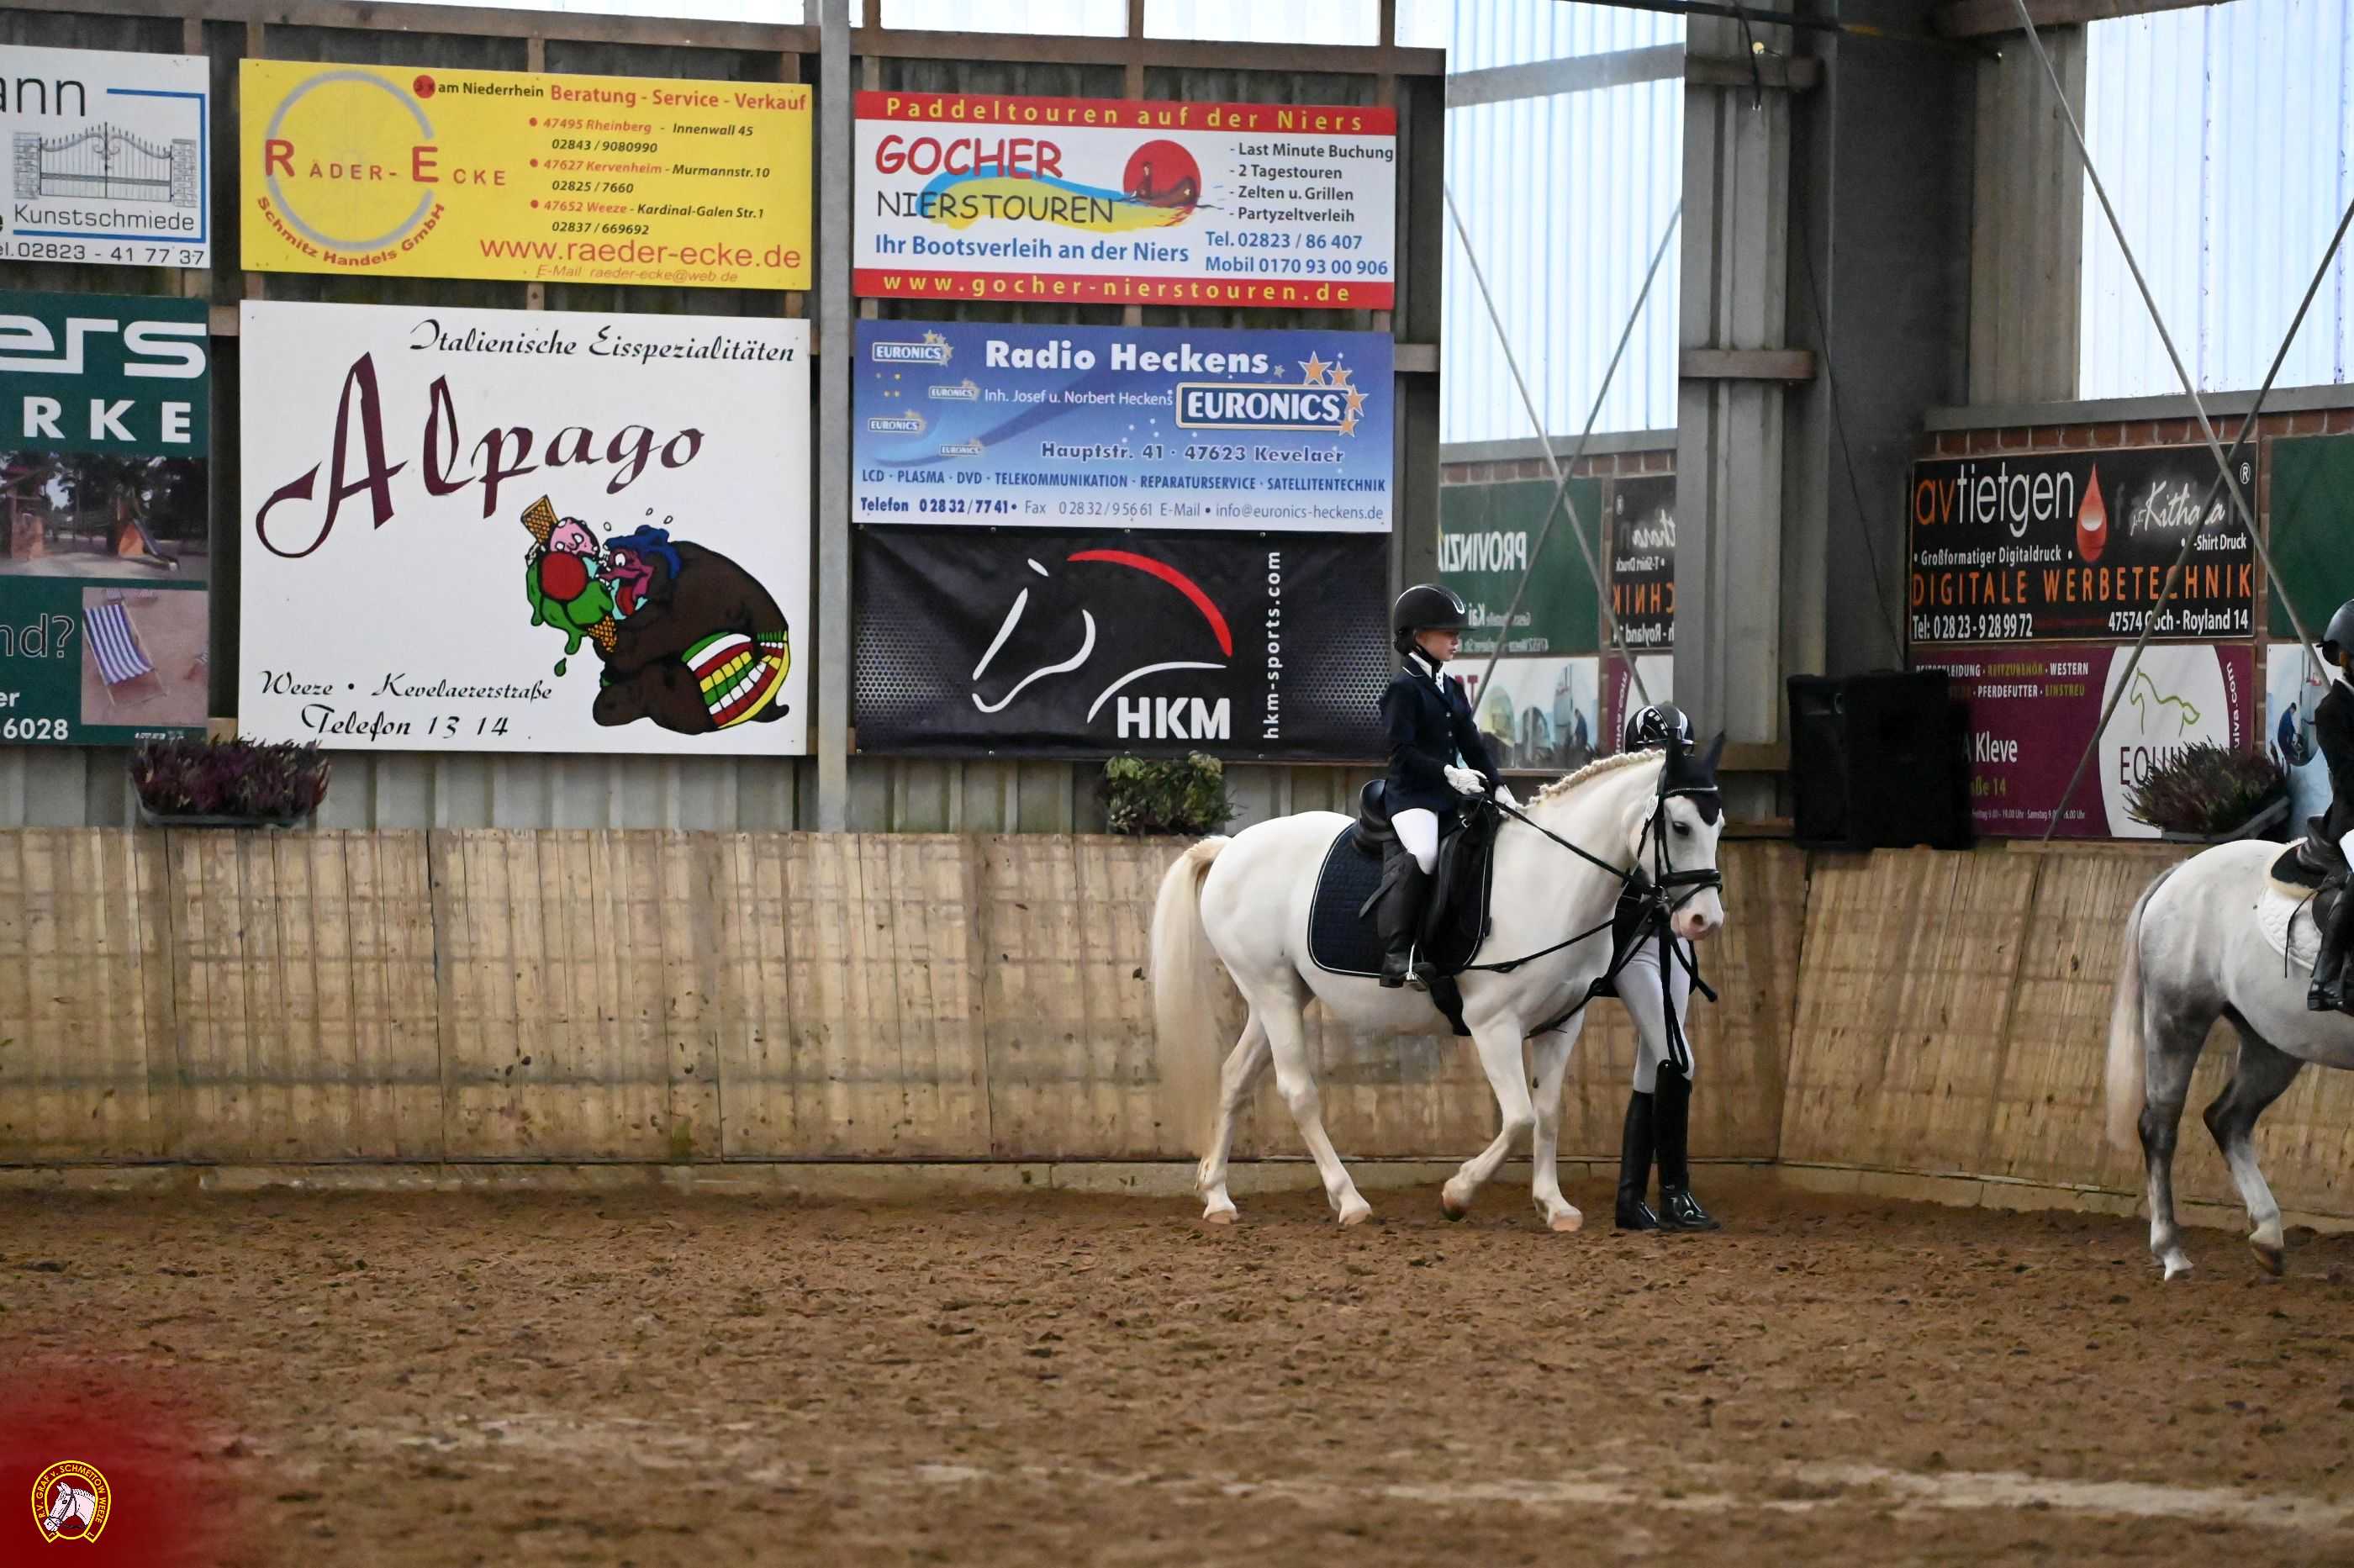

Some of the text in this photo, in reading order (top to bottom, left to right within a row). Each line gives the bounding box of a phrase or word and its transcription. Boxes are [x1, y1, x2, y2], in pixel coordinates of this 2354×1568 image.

[0, 77, 85, 116] nn
[438, 84, 459, 93] am
[463, 82, 544, 98] Niederrhein
[551, 85, 636, 108] Beratung
[652, 89, 719, 107] Service
[735, 92, 806, 111] Verkauf
[542, 118, 753, 136] 47495 Rheinberg Innenwall 45
[887, 98, 1362, 131] Paddeltouren auf der Niers
[552, 139, 657, 153] 02843 9080990
[875, 135, 1063, 180] GOCHER
[1238, 143, 1393, 162] Last Minute Buchung
[544, 159, 583, 170] 47627
[586, 161, 662, 174] Kervenheim
[1238, 165, 1342, 181] 2 Tagestouren
[552, 181, 634, 193] 02825 7660
[1238, 186, 1354, 201] Zelten u. Grillen
[15, 203, 194, 230] Kunstschmiede
[544, 200, 583, 212] 47652
[587, 201, 627, 214] Weeze
[637, 203, 733, 218] Kardinal-Galen
[877, 191, 1113, 224] NIERSTOUREN
[1238, 207, 1354, 223] Partyzeltverleih
[257, 196, 445, 267] Schmitz Handels GmbH
[552, 222, 649, 235] 02837 669692
[1206, 230, 1362, 250] Tel. 02823 86 407
[111, 247, 133, 261] 41
[145, 249, 170, 262] 77
[180, 251, 204, 265] 37
[480, 239, 801, 268] www.raeder-ecke.de
[876, 234, 1189, 261] Ihr Bootsverleih an der Niers
[1205, 256, 1387, 274] Mobil 0170 93 00 906
[884, 275, 1350, 301] www.gocher-nierstouren.de
[410, 318, 795, 366] Italienische Eisspezialitäten
[877, 346, 942, 359] EURONICS
[986, 340, 1269, 374] Radio Heckens
[985, 388, 1173, 405] Inh. Josef u. Norbert Heckens
[1187, 391, 1340, 421] EURONICS
[255, 351, 705, 559] Alpago
[1042, 441, 1344, 462] Hauptstr. 41 47623 Kevelaer
[863, 469, 1385, 492] LCD PLASMA DVD TELEKOMMUNIKATION REPARATURSERVICE SATELLITENTECHNIK
[861, 497, 908, 511] Telefon
[1025, 501, 1046, 514] Fax
[1160, 503, 1200, 516] E-Mail
[1217, 504, 1384, 520] info@euronics-heckens.de
[1915, 462, 2074, 538] avtietgen
[2145, 480, 2225, 531] Kithaa
[1921, 547, 1996, 570] Großformatiger
[1998, 545, 2061, 566] Digitaldruck
[2219, 532, 2246, 550] Druck
[1912, 570, 2027, 606] DIGITALE
[1913, 614, 1930, 639] Tel:
[2109, 611, 2142, 631] 47574
[2183, 608, 2230, 636] Royland
[2234, 610, 2248, 629] 14
[1264, 552, 1283, 739] hkm-sports.com
[2050, 662, 2088, 676] WESTERN
[261, 671, 552, 703] Weeze Kevelaererstraße
[1977, 684, 2038, 699] PFERDEFUTTER
[301, 703, 509, 742] Telefon 13 14
[1117, 696, 1230, 740] HKM
[1976, 732, 2018, 763] Kleve
